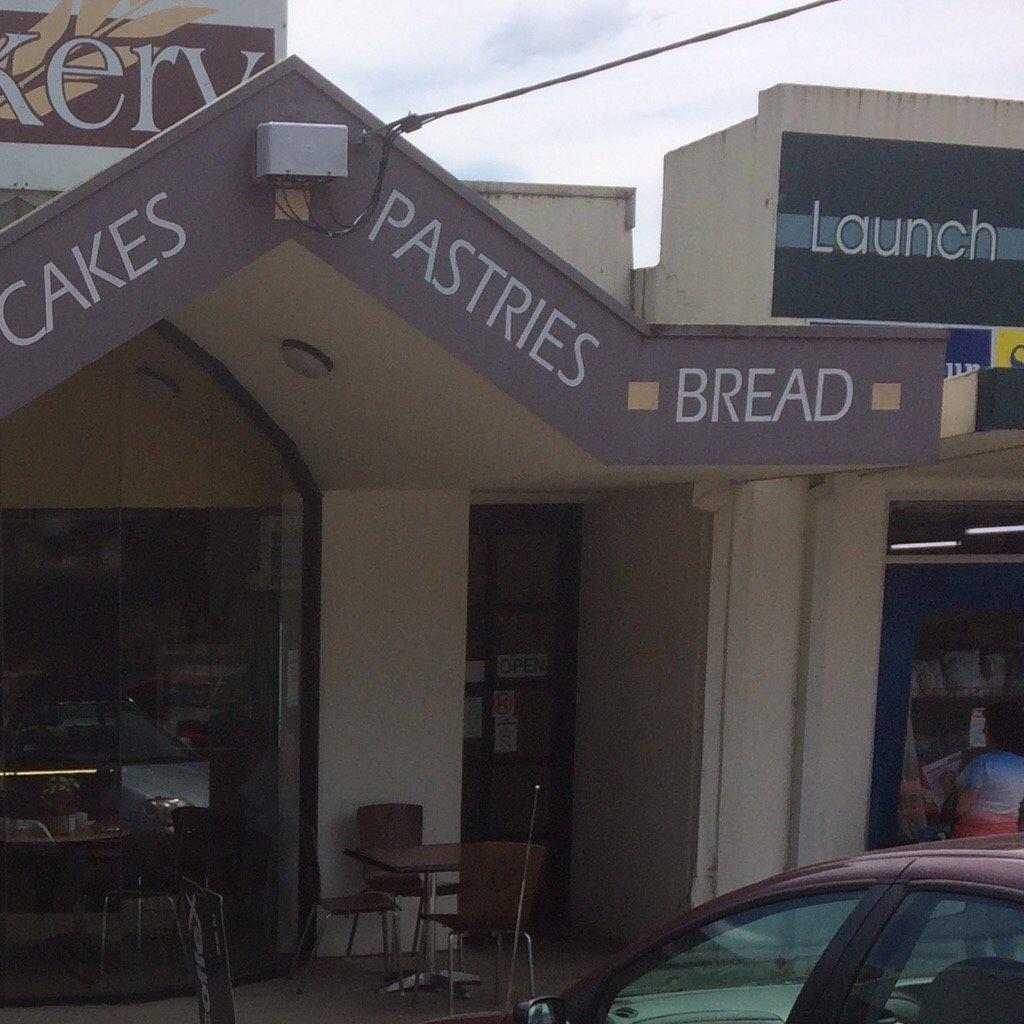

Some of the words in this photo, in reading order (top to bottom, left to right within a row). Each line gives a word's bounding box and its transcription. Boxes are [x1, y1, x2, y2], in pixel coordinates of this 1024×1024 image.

[810, 200, 997, 262] Launch
[368, 189, 600, 388] PASTRIES
[675, 368, 854, 424] BREAD
[500, 657, 546, 674] OPEN
